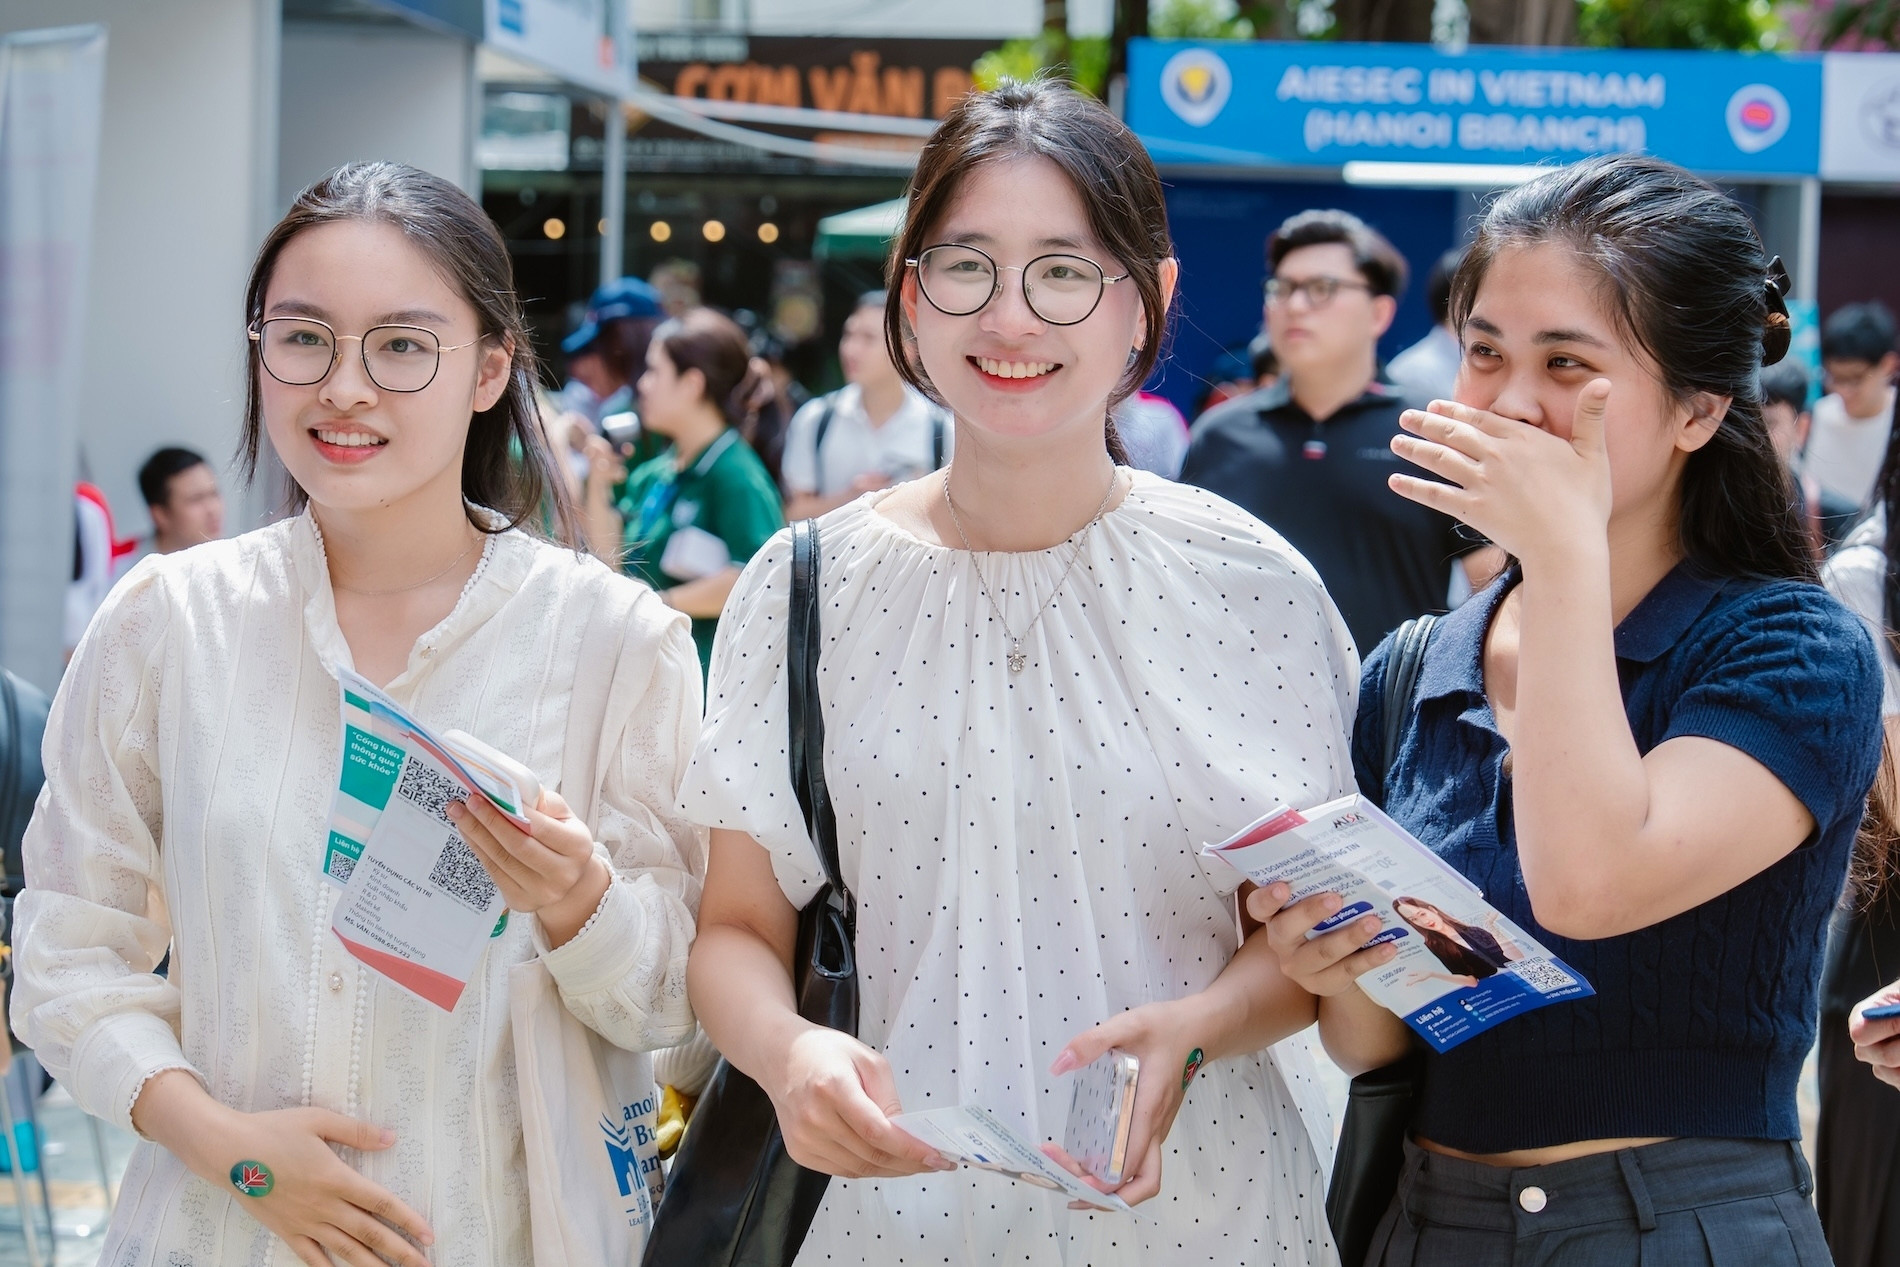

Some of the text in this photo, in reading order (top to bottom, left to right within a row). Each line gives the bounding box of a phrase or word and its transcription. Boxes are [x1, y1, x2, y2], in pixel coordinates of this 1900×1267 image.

[1276, 64, 1667, 110] AIESEC IN VIETNAM
[1303, 107, 1646, 153] (HANOI BRANCH)
[349, 753, 367, 765] sức
[351, 742, 377, 760] thông
[378, 756, 395, 769] qua
[380, 742, 400, 760] hiến
[334, 836, 360, 855] Liên hệ
[372, 867, 380, 876] Kỹ
[1264, 858, 1293, 874] DOANH
[1290, 848, 1316, 863] NGHIỆP
[1281, 865, 1303, 877] CÔNG
[1301, 856, 1323, 870] NGHỆ
[1320, 847, 1347, 862] THÔNG
[1345, 842, 1361, 852] TIN
[367, 855, 433, 898] TUYỂN DỤNG CÁC VỊ TRÍ
[369, 873, 401, 898] Kinh doanh
[359, 895, 382, 912] Thiết kế
[366, 881, 408, 911] Xuất nhập khẩu
[344, 915, 355, 926] MS.
[354, 902, 381, 922] Maketing
[348, 907, 427, 959] Thông tin liên hệ tuyển dụng
[622, 1090, 656, 1122] anoi
